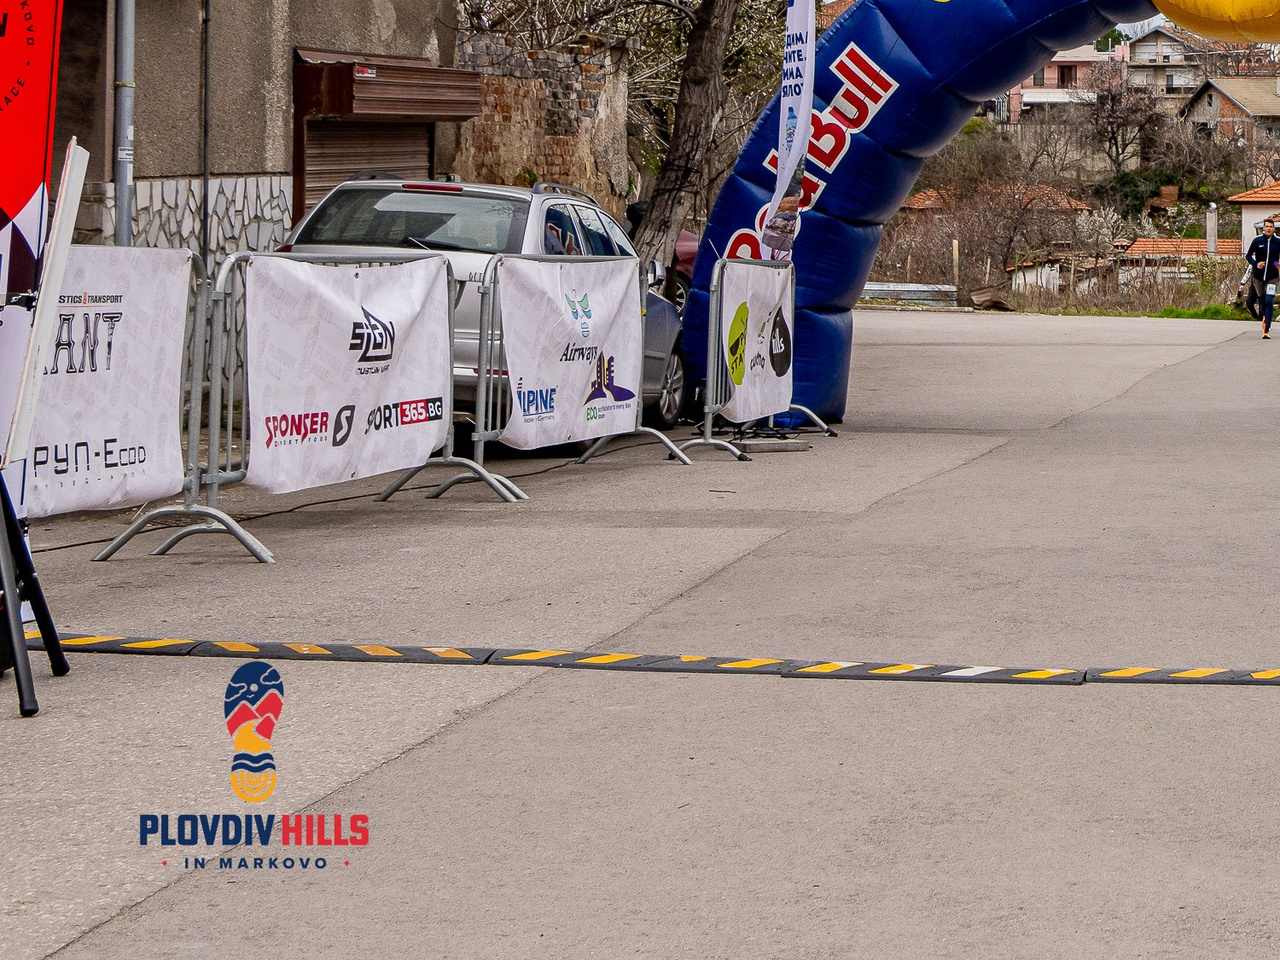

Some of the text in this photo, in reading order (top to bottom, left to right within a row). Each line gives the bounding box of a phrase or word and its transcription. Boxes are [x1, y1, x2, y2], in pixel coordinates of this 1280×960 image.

[807, 41, 900, 174] Bull
[43, 312, 123, 375] ANT
[559, 342, 599, 365] Airways
[264, 412, 330, 449] SPONSER
[586, 406, 598, 421] ECO
